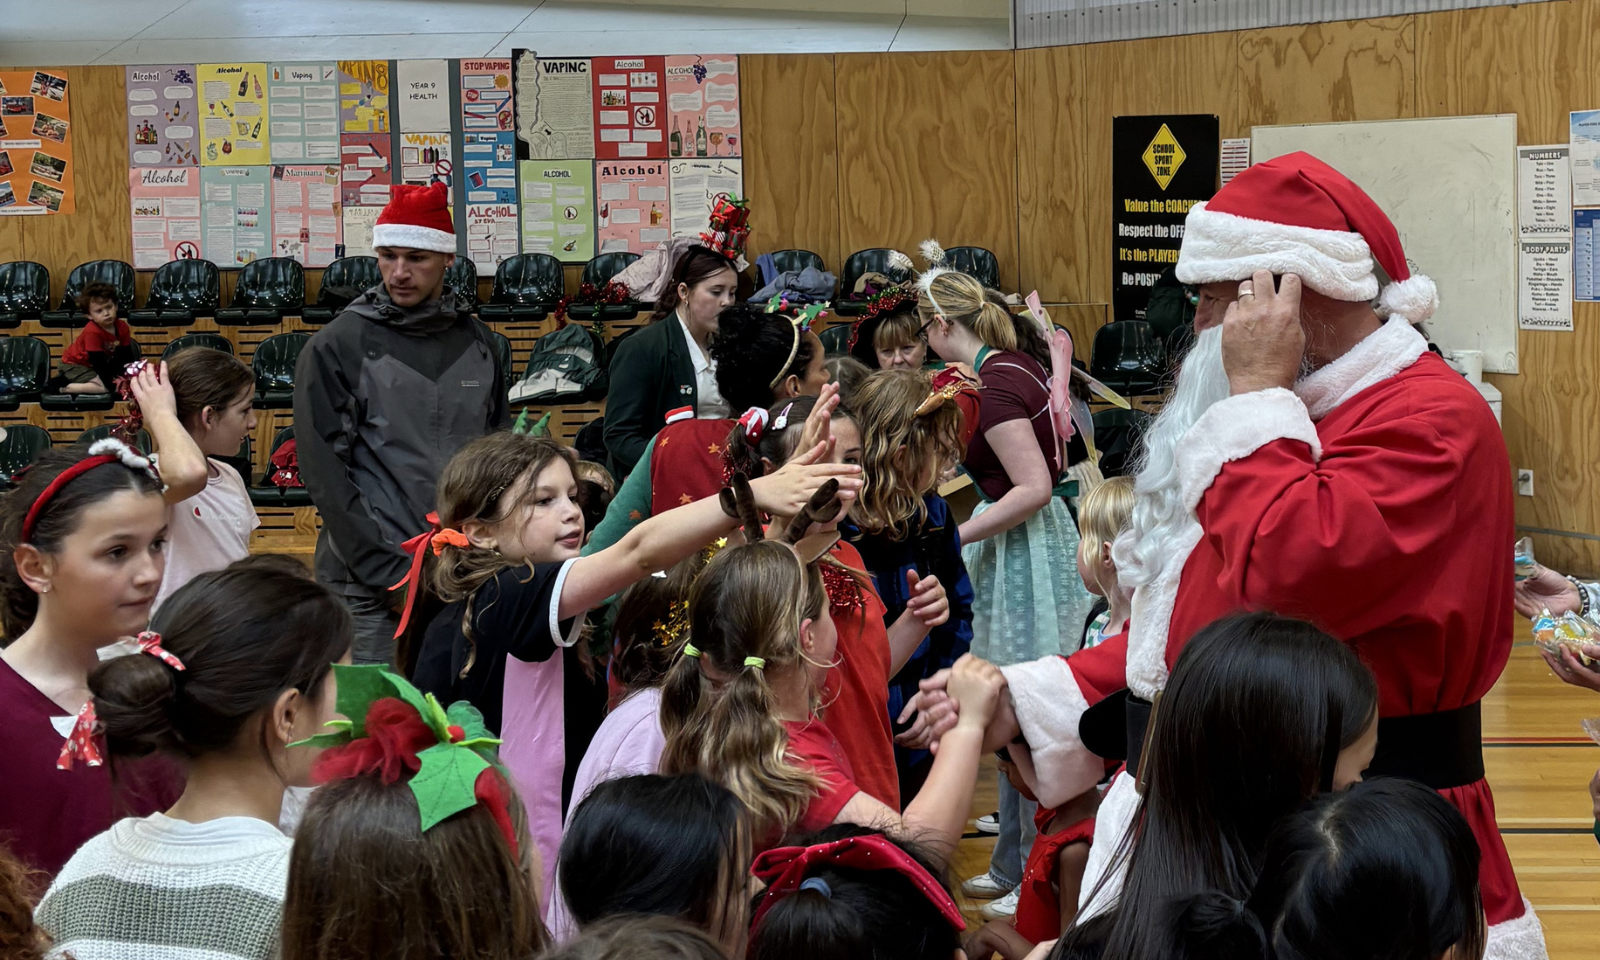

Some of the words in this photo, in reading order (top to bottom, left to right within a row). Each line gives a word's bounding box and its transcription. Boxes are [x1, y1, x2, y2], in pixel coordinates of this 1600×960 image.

[464, 62, 484, 70] STOP
[484, 62, 510, 70] VAPING
[543, 62, 587, 73] VAPING
[132, 72, 160, 80] Alcohol
[292, 72, 313, 80] Vaping
[405, 134, 450, 145] VAPING
[1152, 144, 1175, 154] SCHOOL
[1154, 155, 1173, 165] SPORT
[286, 169, 322, 178] Marijuana
[602, 166, 662, 176] Alcohol
[1156, 167, 1170, 176] ZONE
[142, 170, 186, 184] Alcohol
[1124, 199, 1148, 212] Value
[1150, 199, 1164, 212] the
[468, 206, 517, 218] ALCOHOL
[1119, 223, 1153, 238] Respect
[1154, 224, 1168, 238] the
[1170, 224, 1185, 238] OFF
[1120, 248, 1132, 261] It's
[1134, 248, 1148, 262] the
[1122, 272, 1134, 285] Be
